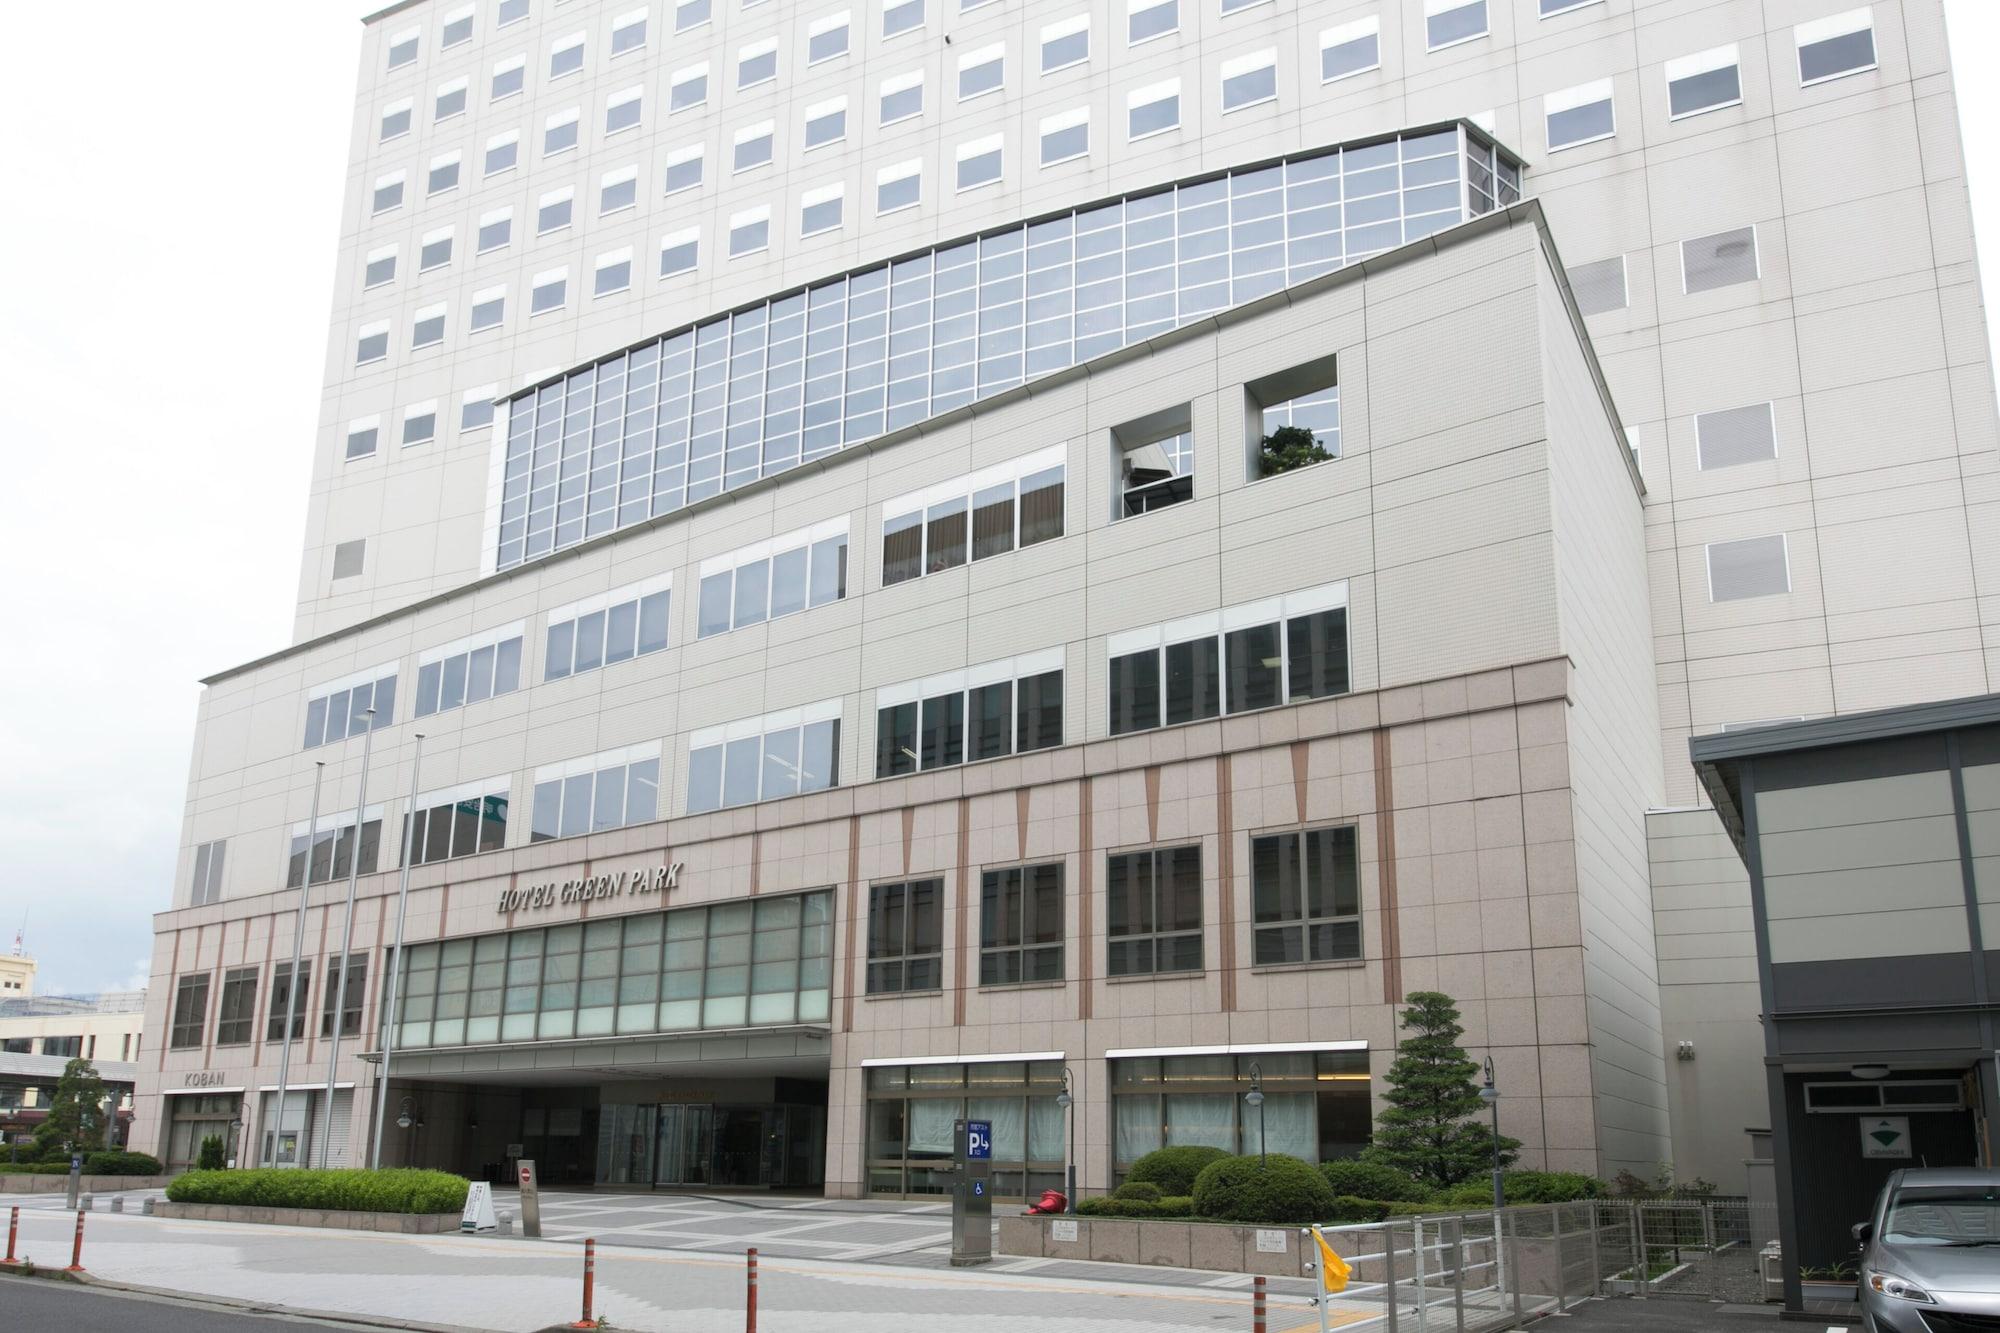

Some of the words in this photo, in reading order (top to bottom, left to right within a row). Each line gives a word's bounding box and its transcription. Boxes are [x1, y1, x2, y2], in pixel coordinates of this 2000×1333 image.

[497, 882, 555, 913] HOTEL
[560, 871, 626, 905] GREEN
[628, 862, 684, 895] PARK
[184, 1071, 225, 1087] KOBAN
[969, 1132, 980, 1155] P
